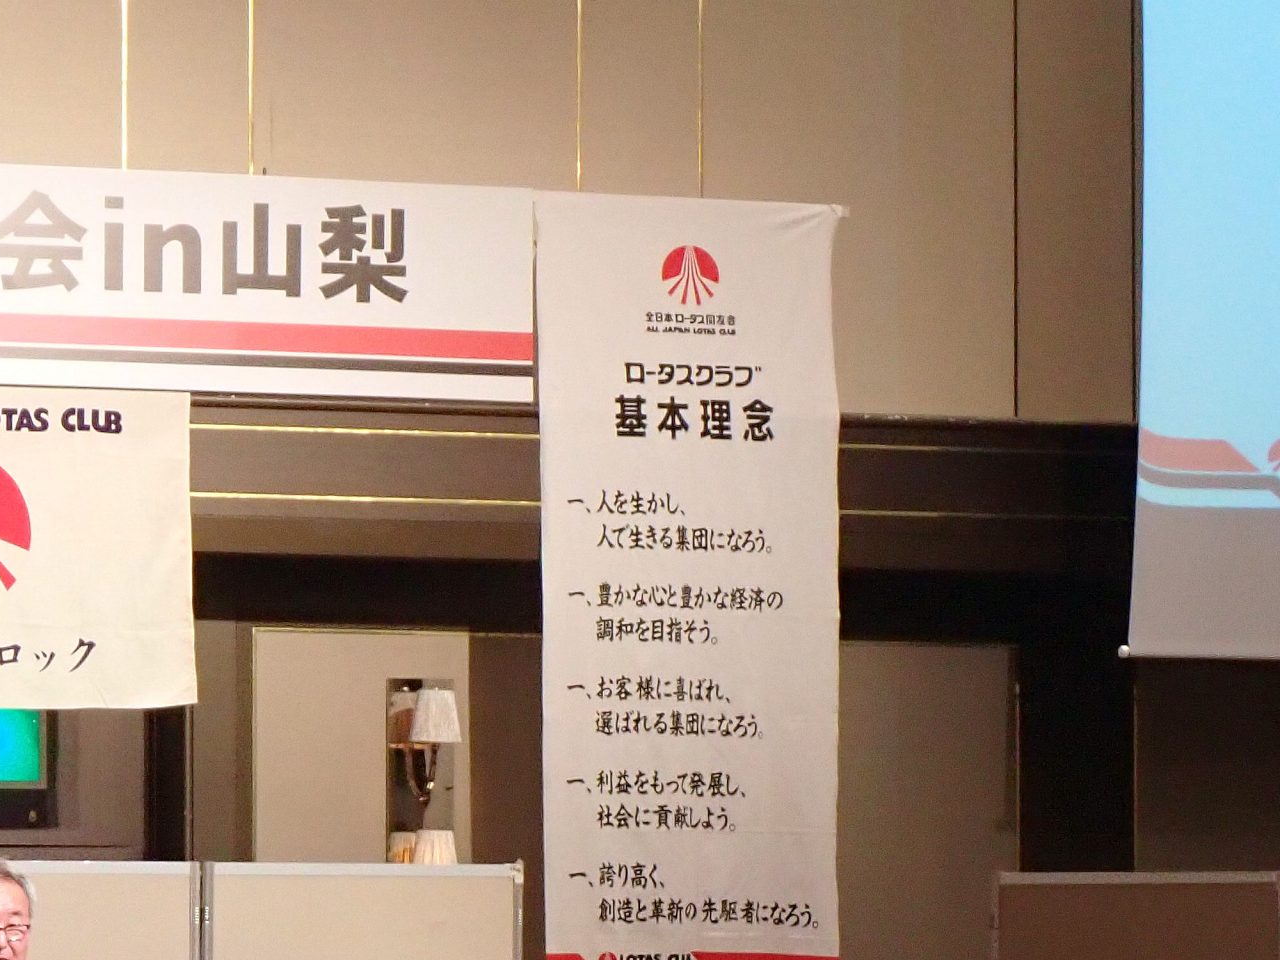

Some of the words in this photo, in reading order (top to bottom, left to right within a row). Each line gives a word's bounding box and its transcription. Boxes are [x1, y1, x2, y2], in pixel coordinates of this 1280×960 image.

[624, 361, 762, 388] ロータスクラブ
[60, 407, 122, 434] CLUB
[614, 393, 775, 442] 基本理念
